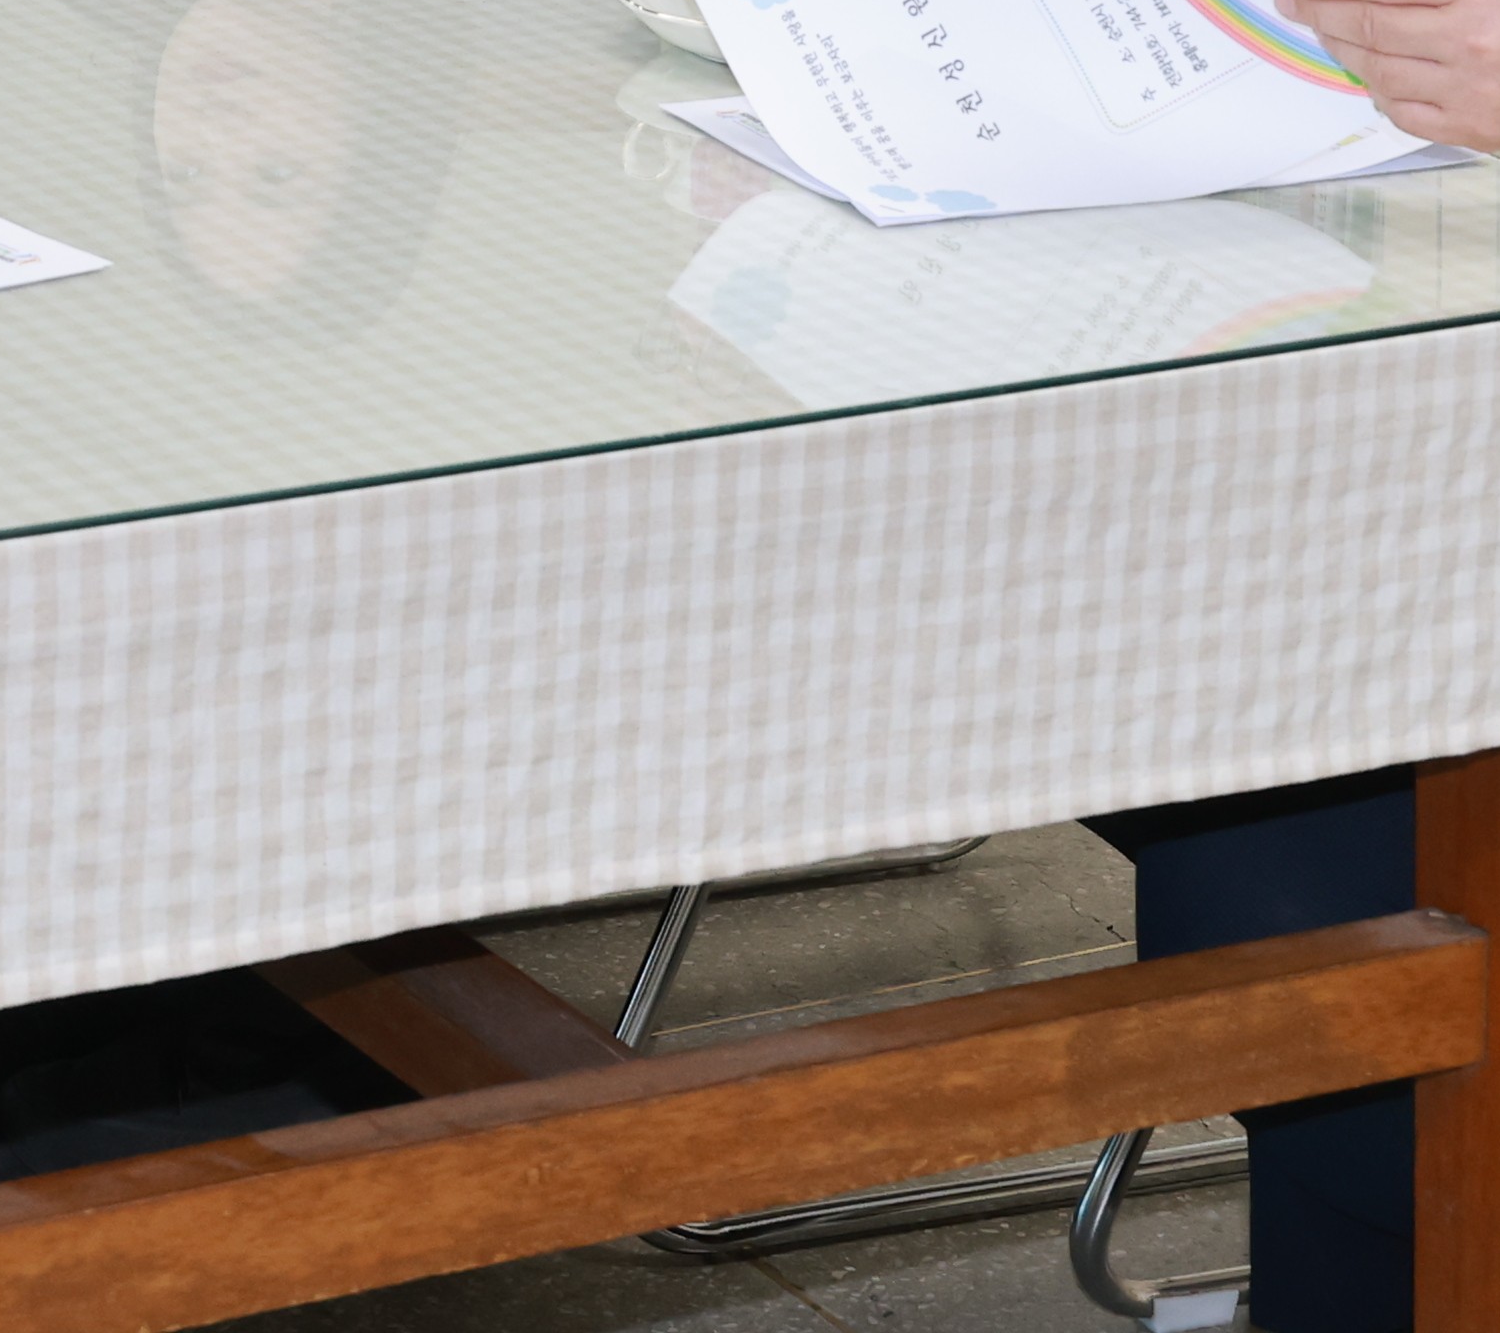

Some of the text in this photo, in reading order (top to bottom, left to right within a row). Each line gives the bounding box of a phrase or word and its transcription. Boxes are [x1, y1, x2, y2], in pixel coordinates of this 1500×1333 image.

[782, 10, 806, 46] 사랑을
[1091, 3, 1123, 41] 순천시
[1144, 34, 1182, 87] 전화번호:
[826, 92, 856, 133] 행복하고
[852, 89, 873, 121] 이루는
